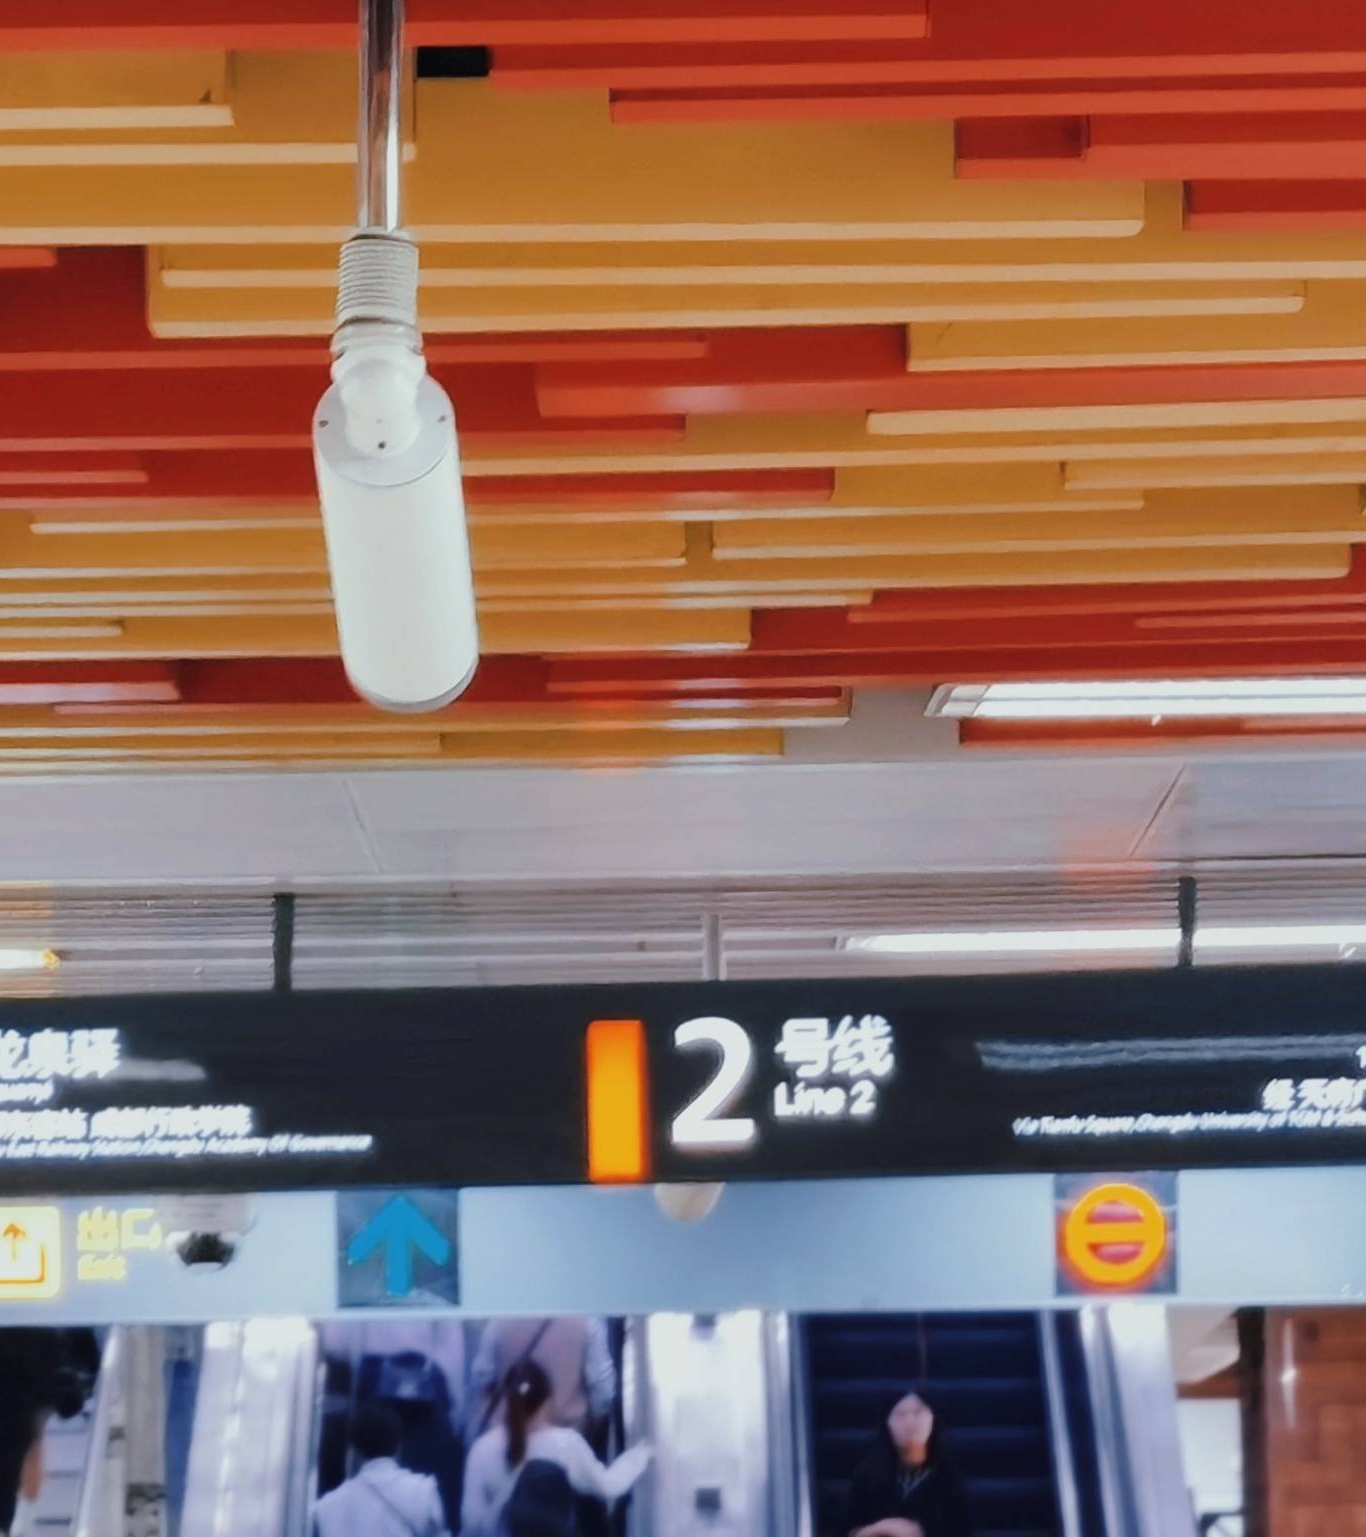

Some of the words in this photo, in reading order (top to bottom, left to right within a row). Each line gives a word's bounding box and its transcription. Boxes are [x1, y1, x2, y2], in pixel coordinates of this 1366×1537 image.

[773, 1014, 895, 1078] 号线
[671, 1016, 756, 1143] 2
[849, 1081, 877, 1115] 2
